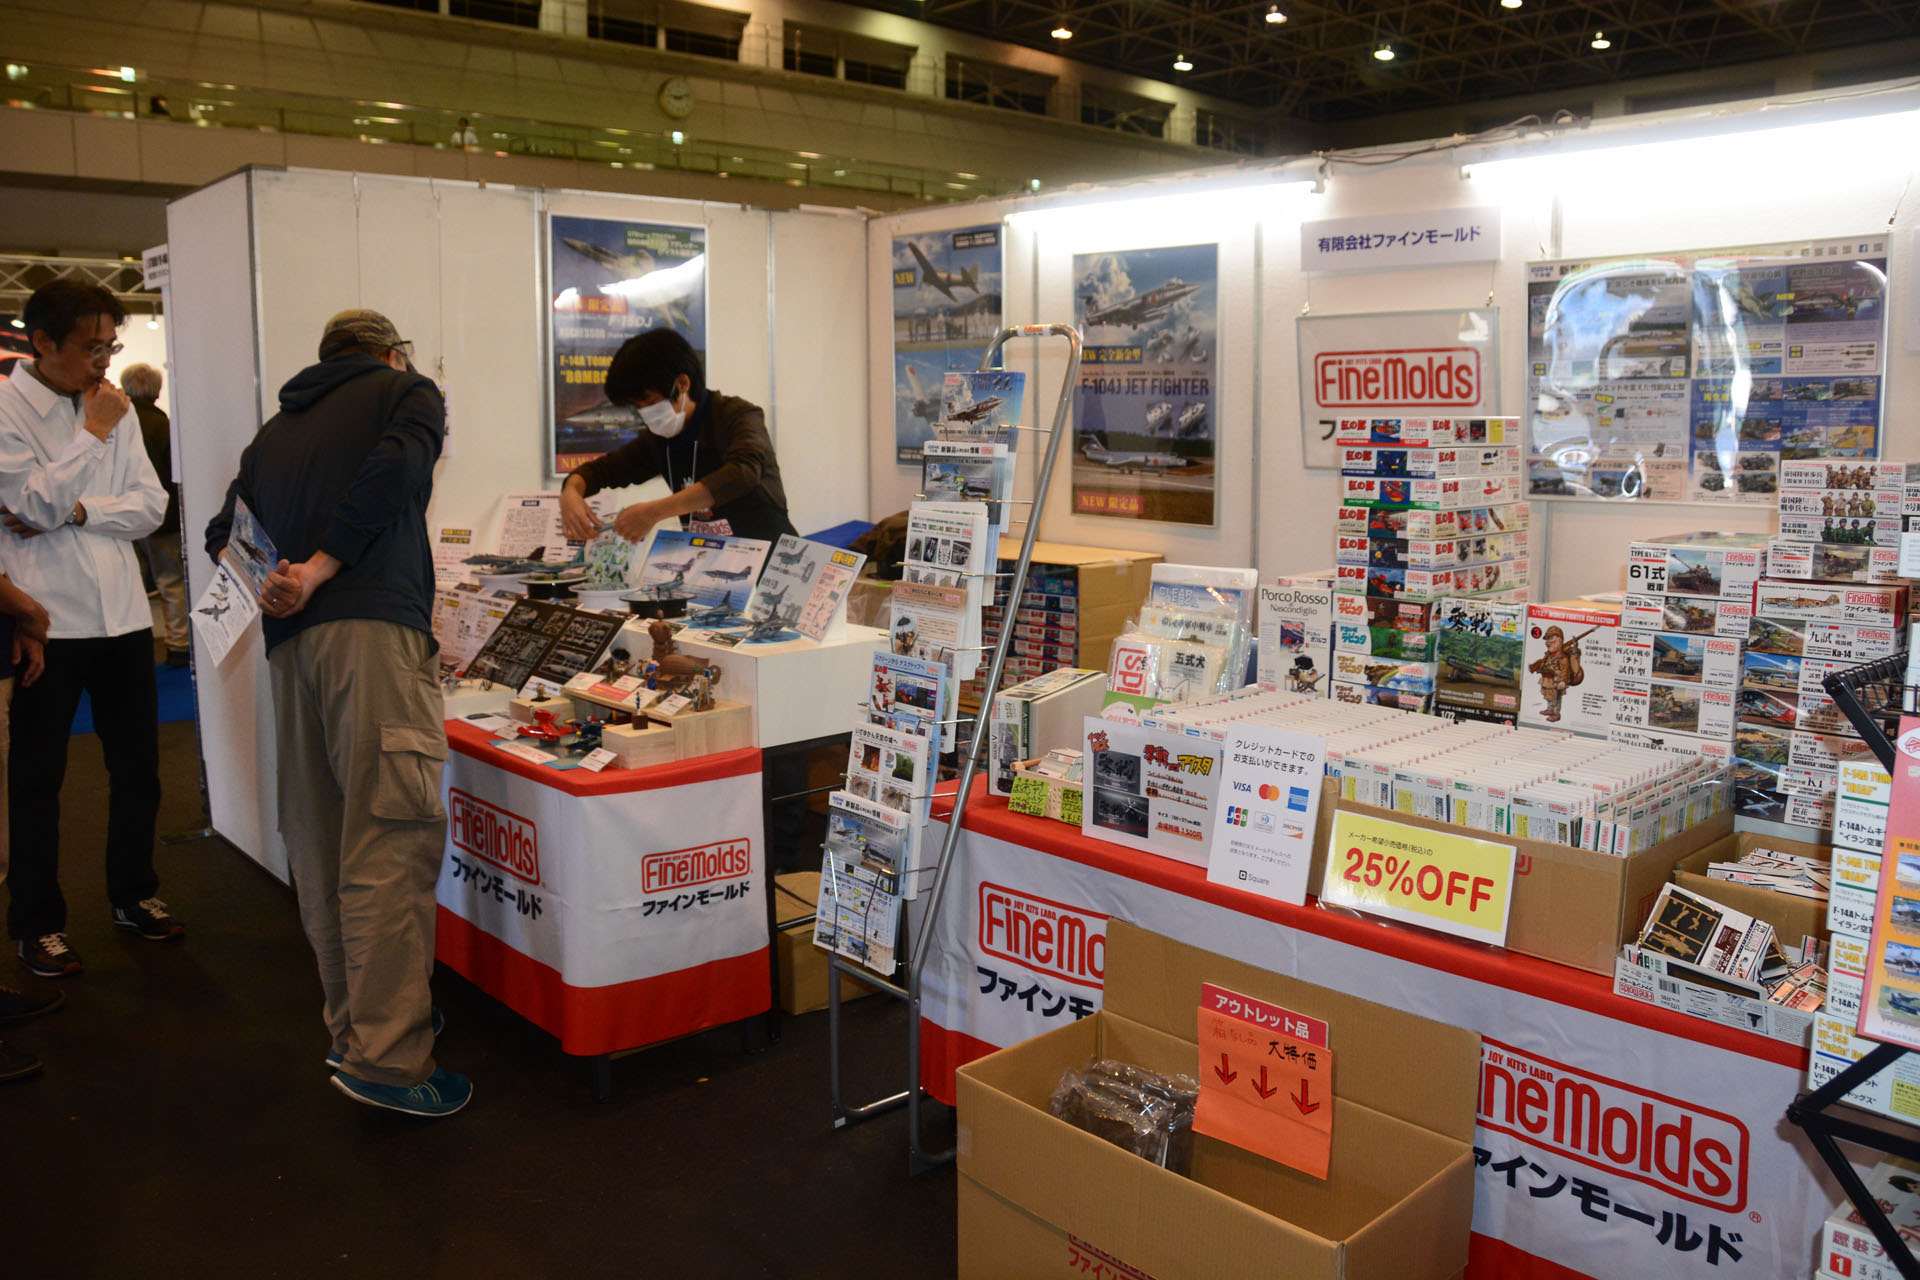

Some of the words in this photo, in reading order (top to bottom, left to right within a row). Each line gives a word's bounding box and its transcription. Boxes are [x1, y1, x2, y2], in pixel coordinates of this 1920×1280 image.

[1318, 226, 1481, 253] 有限会社ファインモールド
[895, 271, 915, 284] NEW
[1081, 378, 1121, 395] F-104J
[1125, 378, 1147, 395] JET
[1151, 378, 1209, 396] FIGHTER
[1321, 356, 1474, 401] FineMolds
[1081, 496, 1105, 509] NEW
[1630, 565, 1665, 580] 61式
[1261, 588, 1293, 602] Porco
[1294, 591, 1329, 606] Rosso
[1647, 582, 1664, 592] 戦車
[1847, 592, 1890, 605] FineMolds
[1270, 603, 1318, 616] Nascondiglio
[1845, 606, 1889, 614] ファインモールド
[1533, 628, 1540, 638] 3
[1832, 648, 1851, 658] Ka-14
[1235, 739, 1315, 762] クレジットカードでの
[1672, 747, 1698, 756] TRAILER
[1233, 753, 1309, 776] お支払いができます。
[1843, 768, 1868, 781] F-14A
[1233, 780, 1252, 793] VISA
[1226, 805, 1248, 828] JCB
[452, 798, 534, 877] FineMolds
[1348, 831, 1433, 857] メーカー希望小売価格(税込)の
[645, 845, 747, 889] FineMolds
[1837, 855, 1863, 868] F-14A
[451, 855, 542, 920] ファインモールド
[1248, 873, 1270, 886] Square
[1343, 847, 1494, 912] 25%OFF
[642, 881, 750, 917] ファインモールド
[1013, 900, 1024, 910] JOY
[1025, 903, 1039, 915] KITS
[986, 893, 1106, 980] FineMo
[977, 965, 1094, 1021] ファインモ
[1215, 994, 1309, 1039] アウトレット品
[1268, 1041, 1317, 1070] 大特価
[1488, 1050, 1504, 1064] JOY
[1507, 1057, 1527, 1074] KITS
[1473, 1146, 1743, 1266] ァインモールド
